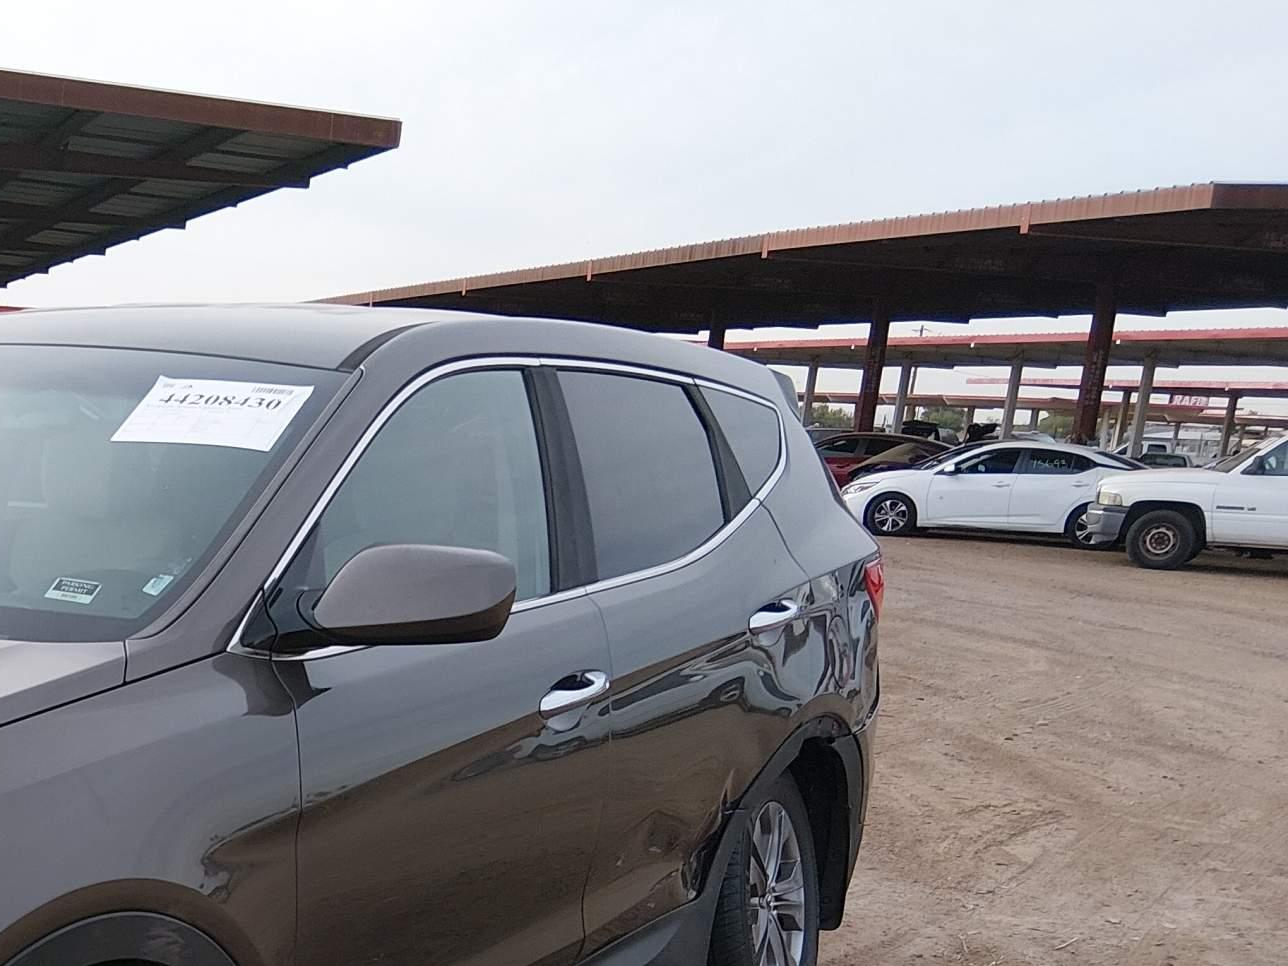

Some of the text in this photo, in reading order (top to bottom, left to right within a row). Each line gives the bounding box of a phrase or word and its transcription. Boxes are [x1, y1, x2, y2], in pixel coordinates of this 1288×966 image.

[158, 393, 282, 410] 44208430
[60, 586, 88, 594] PERMIT
[61, 580, 94, 590] PARKING
